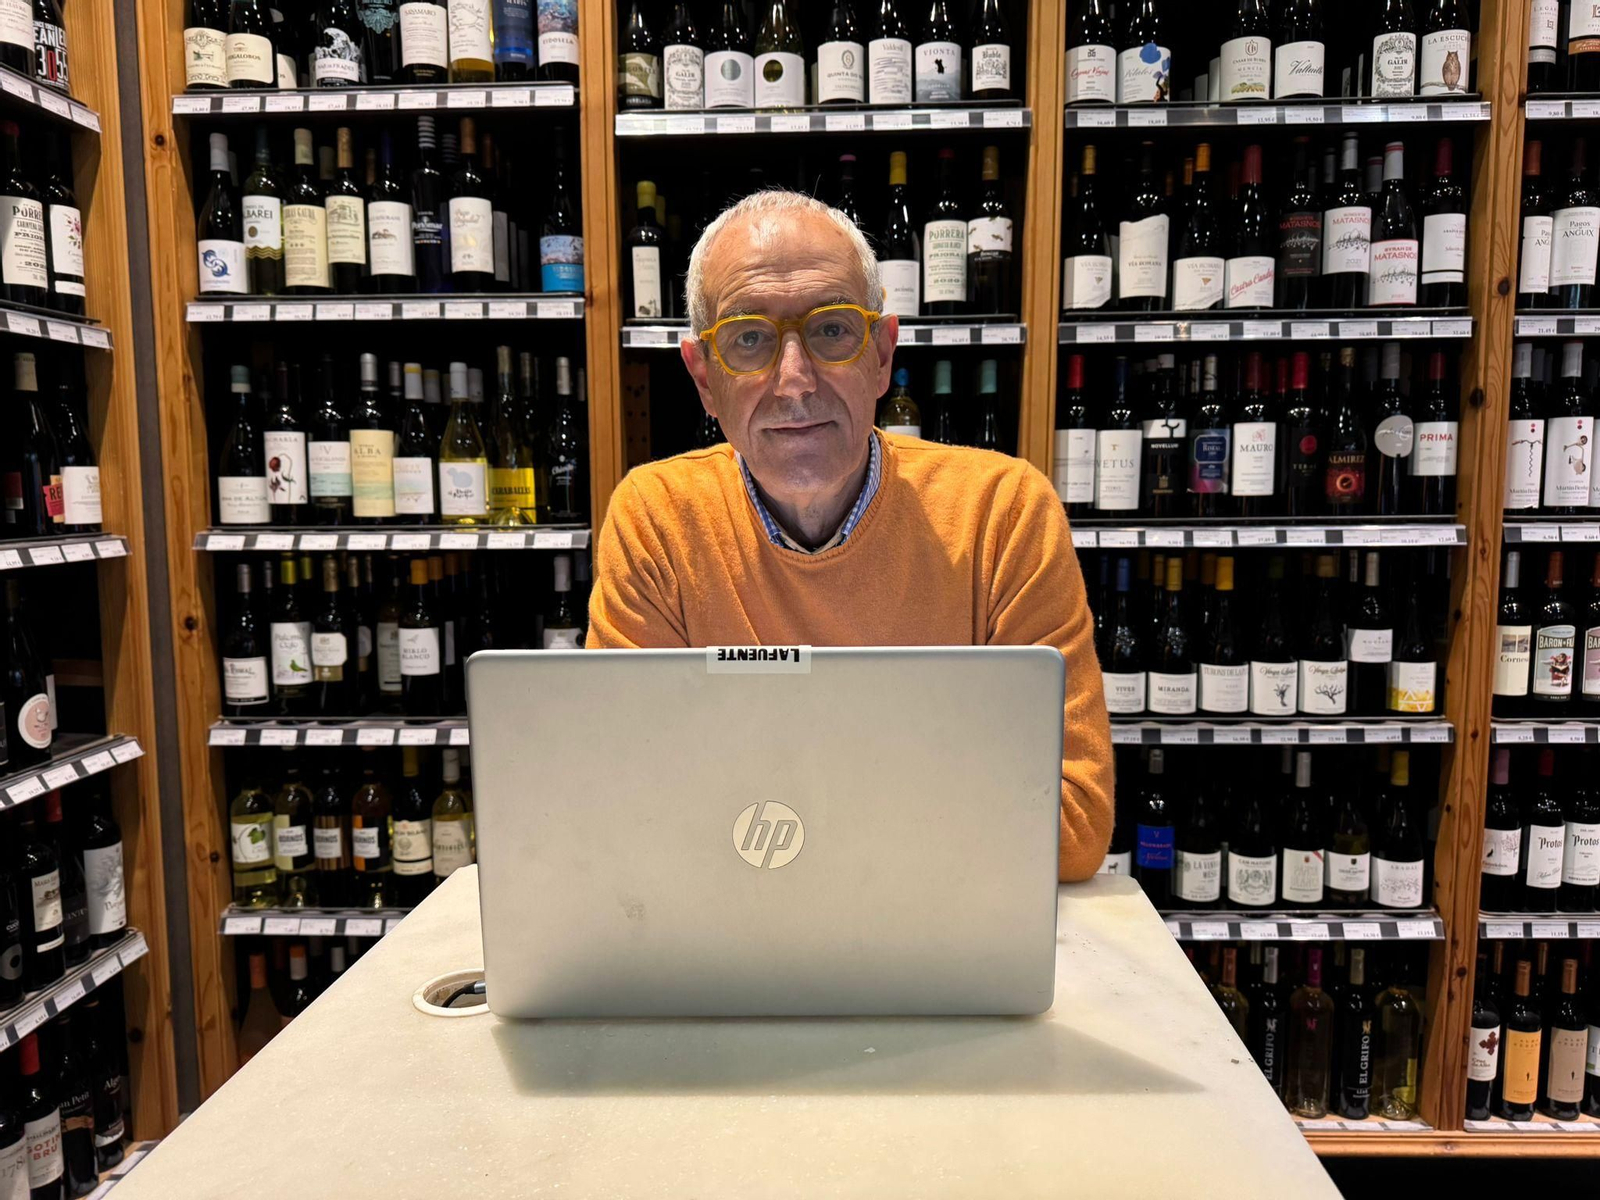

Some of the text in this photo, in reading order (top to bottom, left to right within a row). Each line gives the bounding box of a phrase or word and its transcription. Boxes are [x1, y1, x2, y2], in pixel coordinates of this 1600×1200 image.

[929, 228, 965, 240] PORRERA
[1563, 230, 1594, 238] ANGUIX
[1420, 433, 1453, 442] PRIMA
[1539, 636, 1563, 648] BARON
[718, 648, 800, 662] LAFUENTE
[736, 800, 802, 869] hp
[1572, 834, 1599, 847] Protos
[1538, 837, 1562, 849] Protos
[1360, 1035, 1370, 1070] GRIFO
